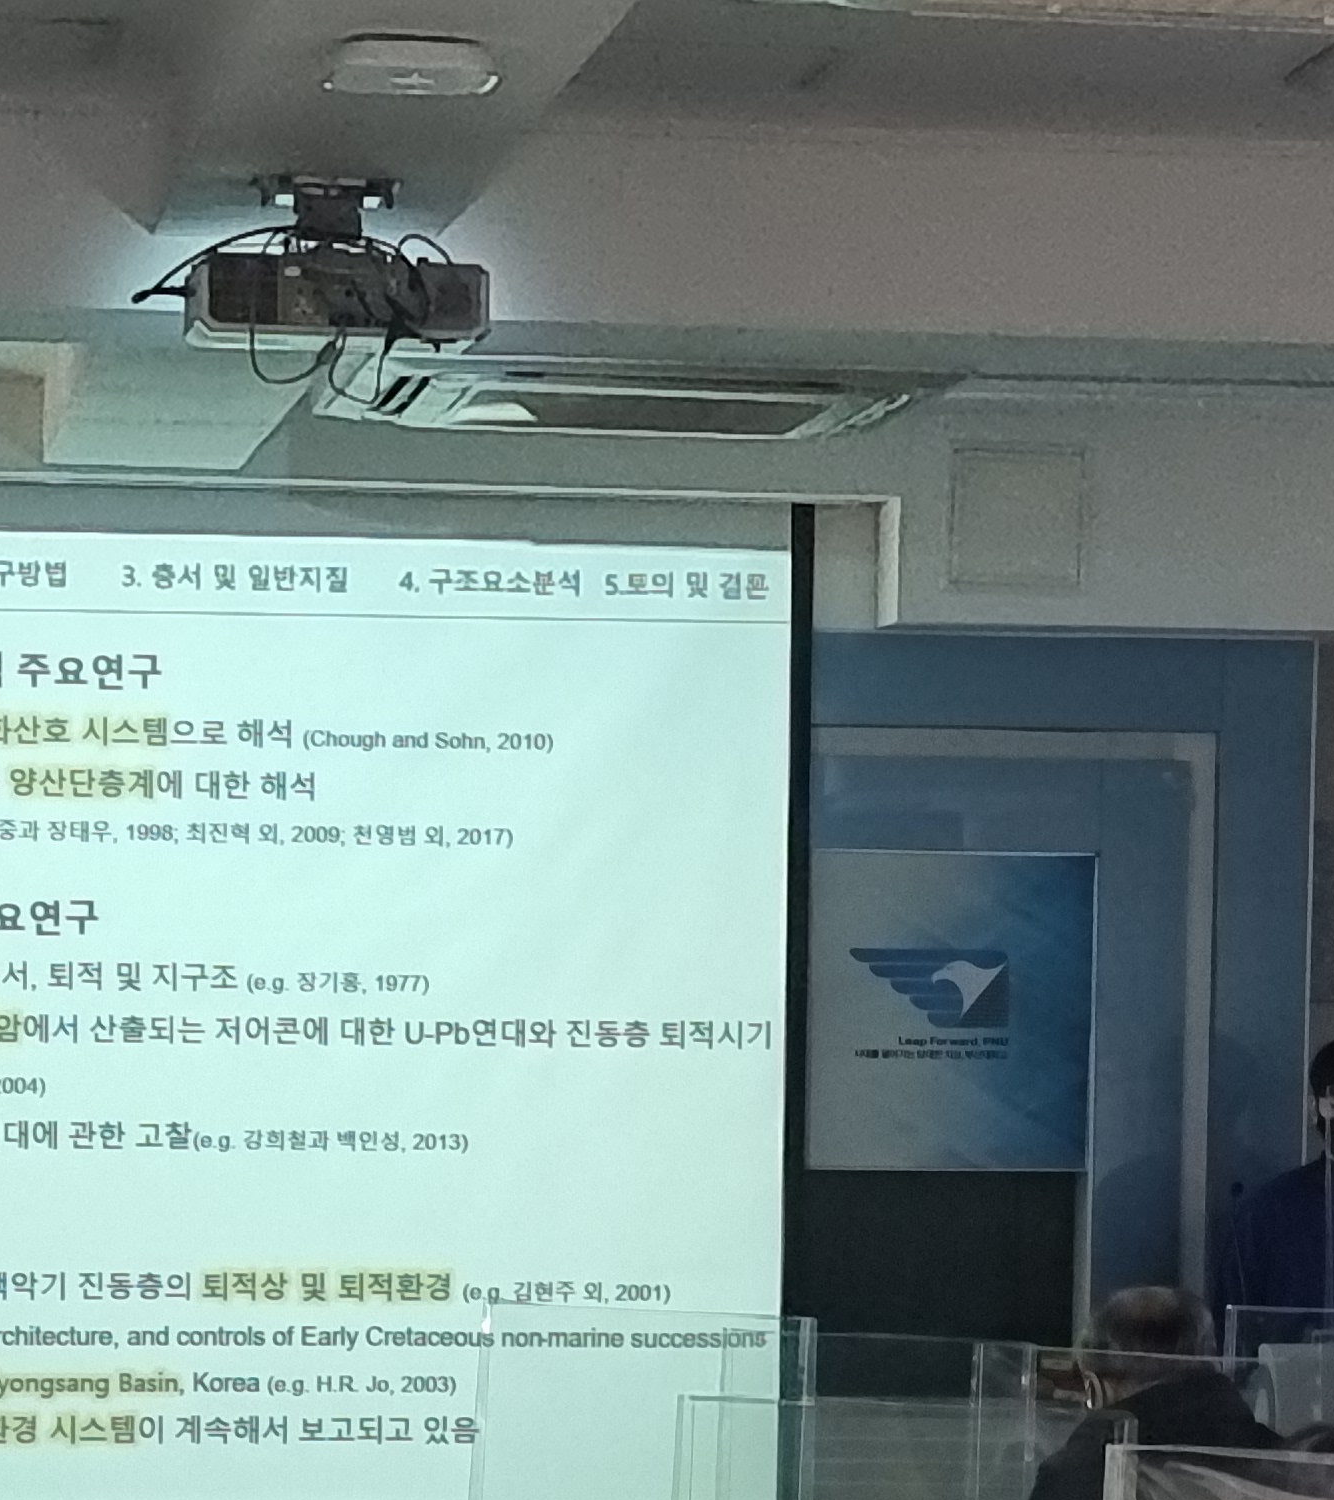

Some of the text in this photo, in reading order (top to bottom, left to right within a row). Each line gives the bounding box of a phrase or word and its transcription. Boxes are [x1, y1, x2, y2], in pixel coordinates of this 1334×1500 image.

[122, 565, 141, 587] 3.
[152, 563, 201, 590] 층서
[214, 564, 236, 590] 및
[399, 569, 580, 597] 4. 구조요소분석
[687, 572, 708, 598] 및
[17, 654, 162, 690] 주요연구
[82, 716, 227, 747] 시스템으로
[237, 719, 291, 749] 해석
[302, 728, 386, 752] (Chough
[392, 732, 429, 748] and
[435, 732, 491, 753] Sohn,
[497, 733, 553, 754] 2010)
[10, 768, 182, 799] 양산단층계에
[195, 771, 251, 800] 대한
[260, 771, 315, 801] 해석
[127, 824, 178, 845] 1998;
[291, 826, 345, 847] 2009;
[457, 828, 513, 849] 2017)
[47, 961, 102, 991] 퇴적
[117, 962, 141, 991] 및
[153, 962, 238, 992] 지구조
[247, 974, 289, 994] (e.g.
[376, 975, 429, 996] 1977)
[90, 1014, 205, 1044] 산출되는
[215, 1016, 328, 1046] 저어콘에
[341, 1017, 395, 1046] 대한
[405, 1019, 557, 1048] U-Pb연대와
[567, 1020, 650, 1048] 진동층
[659, 1020, 771, 1050] 퇴적시기
[69, 1121, 125, 1149] 관한
[413, 1133, 468, 1154] 2013)
[79, 1272, 190, 1301] 진동층의
[202, 1272, 288, 1301] 퇴적상
[301, 1272, 326, 1301] 및
[338, 1272, 450, 1302] 퇴적환경
[463, 1283, 503, 1304] (e.g.
[615, 1284, 671, 1305] 2001)
[127, 1326, 169, 1346] and
[177, 1326, 265, 1346] controls
[272, 1326, 295, 1346] of
[301, 1326, 359, 1351] Early
[366, 1326, 495, 1349] Cretaceous
[502, 1327, 624, 1348] non-marine
[630, 1327, 768, 1349] successions
[119, 1371, 184, 1396] Basin,
[193, 1372, 260, 1392] Korea
[267, 1376, 309, 1396] (e.g.
[366, 1376, 394, 1396] Jo,
[401, 1376, 456, 1396] 2003)
[50, 1415, 163, 1445] 시스템이
[175, 1415, 287, 1444] 계속해서
[298, 1415, 413, 1445] 보고되고
[424, 1416, 481, 1445] 있음
